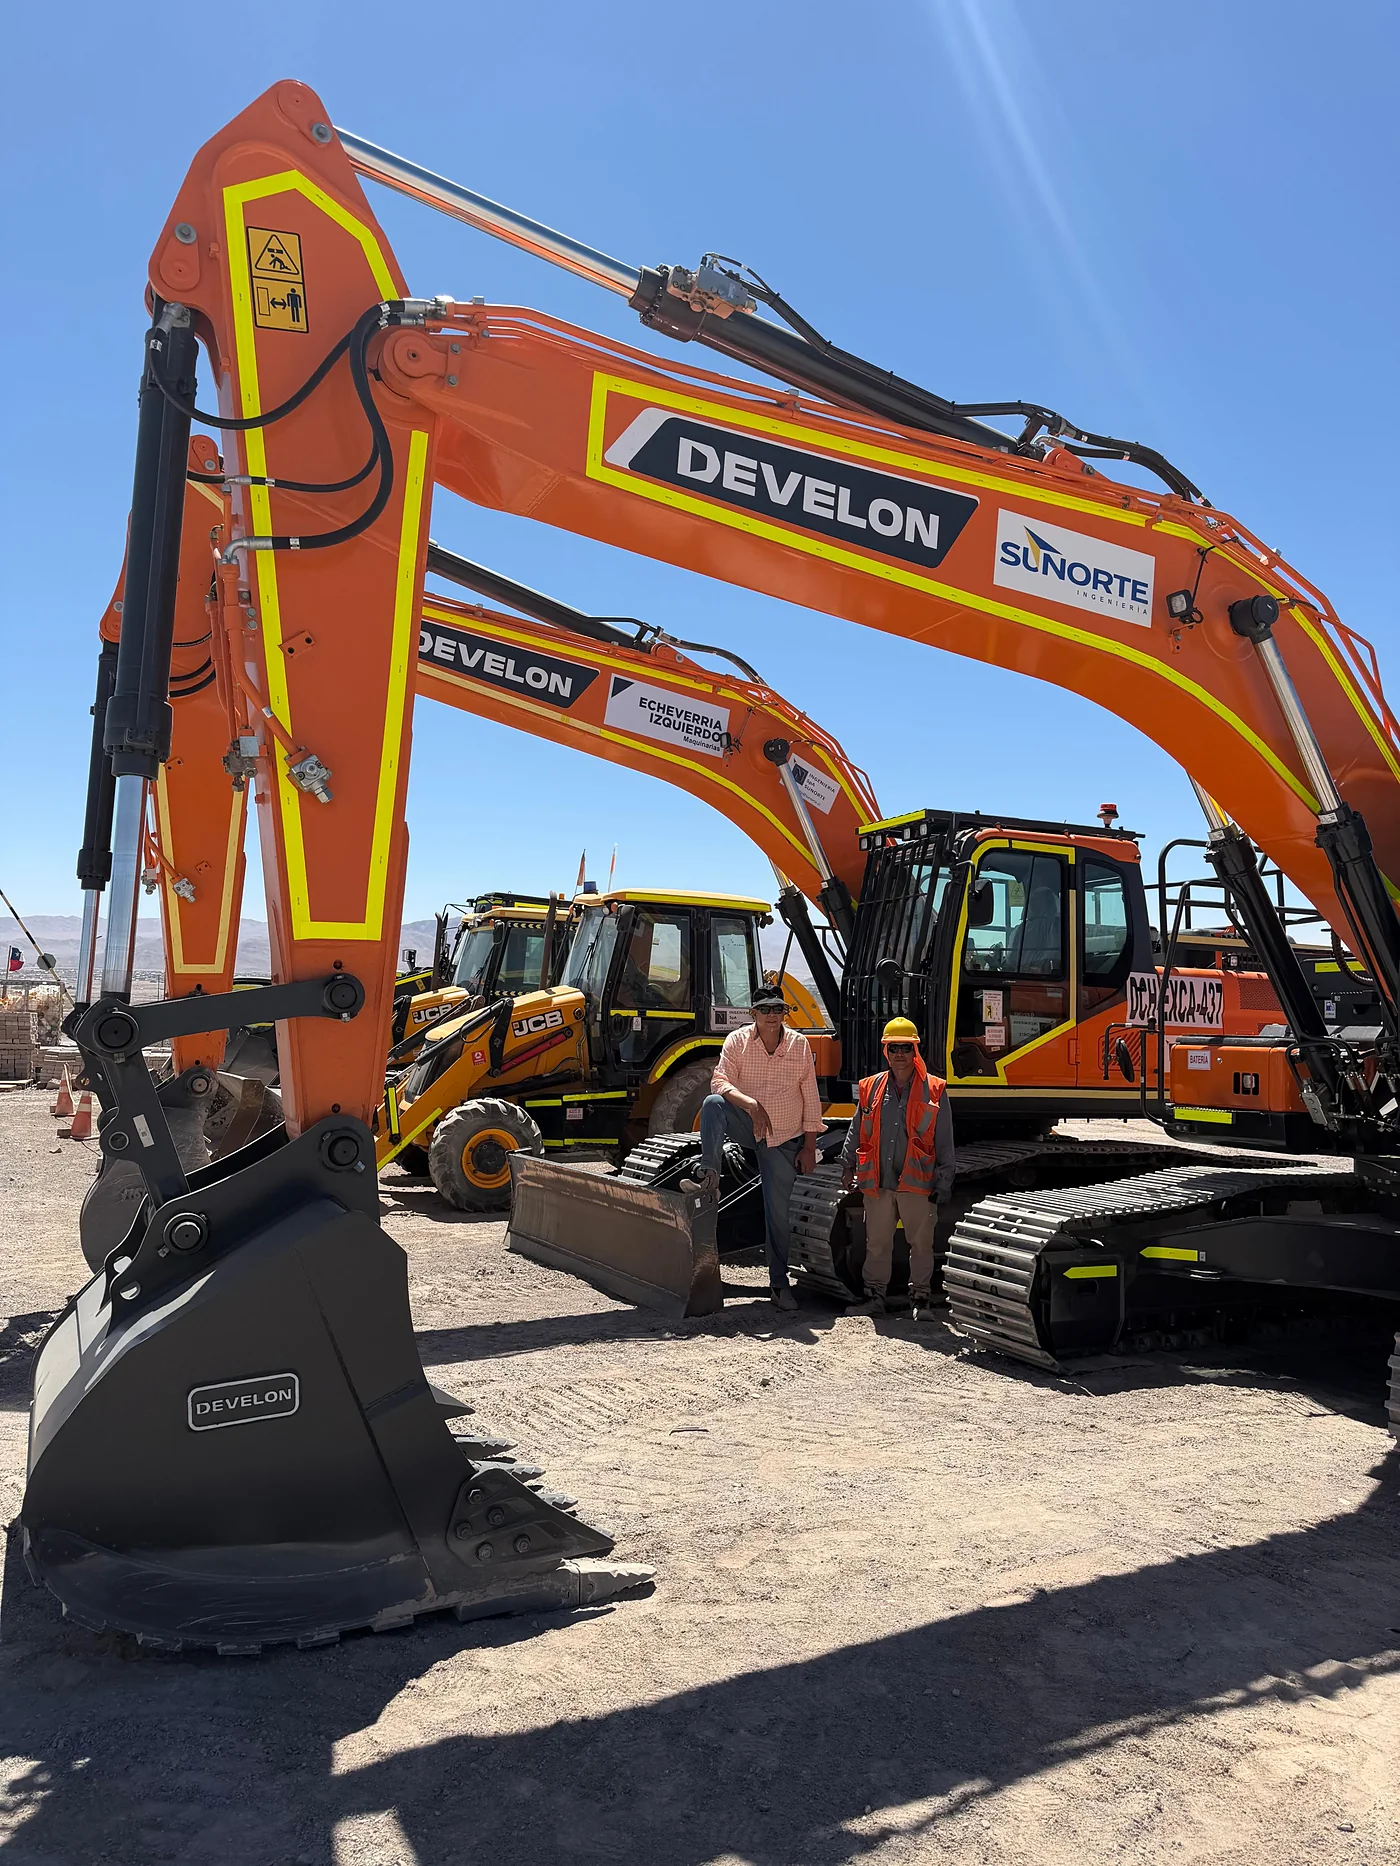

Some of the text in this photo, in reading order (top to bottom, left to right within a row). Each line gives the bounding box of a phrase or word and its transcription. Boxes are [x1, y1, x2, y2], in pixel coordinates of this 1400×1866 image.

[676, 436, 941, 550] DEVELON
[1000, 541, 1149, 605] SUNORTE
[639, 697, 722, 731] ECHEVERRIA
[649, 713, 721, 743] IZQUIERDO
[683, 736, 720, 752] Maquinarias
[414, 1003, 452, 1023] JCB
[513, 1010, 563, 1036] JCB
[1190, 1052, 1208, 1064] BATERÍA
[196, 1389, 292, 1415] DEVELON
